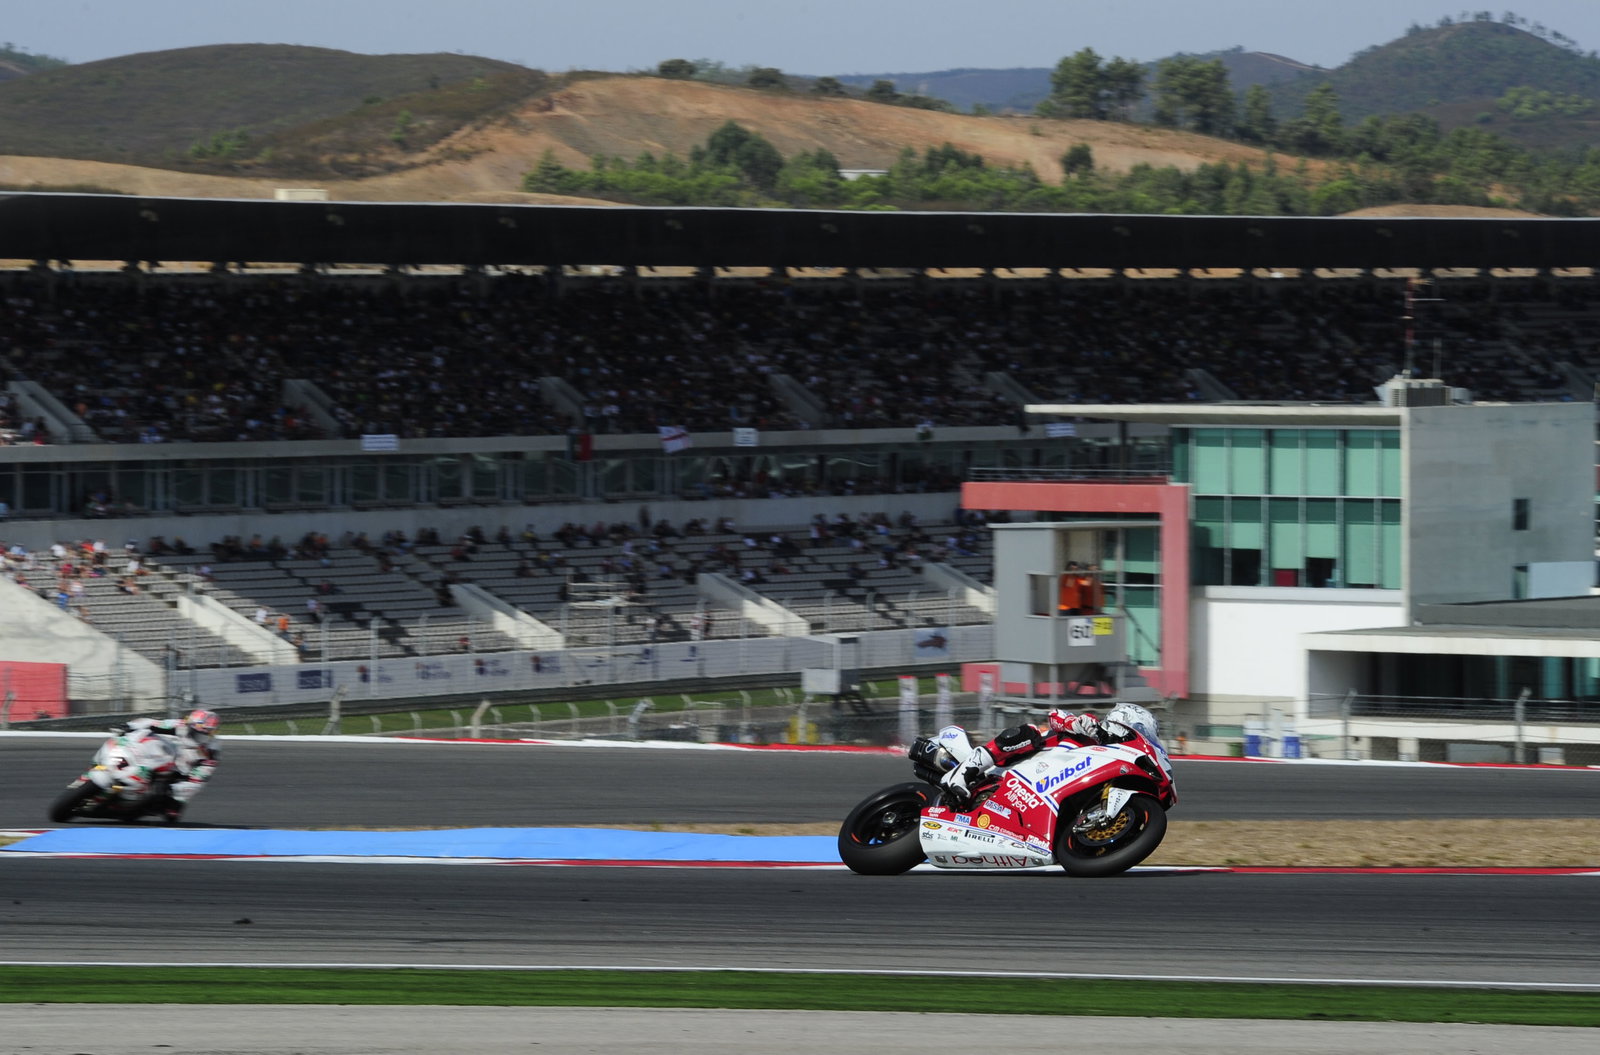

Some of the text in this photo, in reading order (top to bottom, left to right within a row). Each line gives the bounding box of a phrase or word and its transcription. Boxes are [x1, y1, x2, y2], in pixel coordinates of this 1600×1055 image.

[1035, 755, 1092, 793] Unibat
[964, 829, 996, 844] PIRELLI
[952, 855, 1028, 867] Althea
